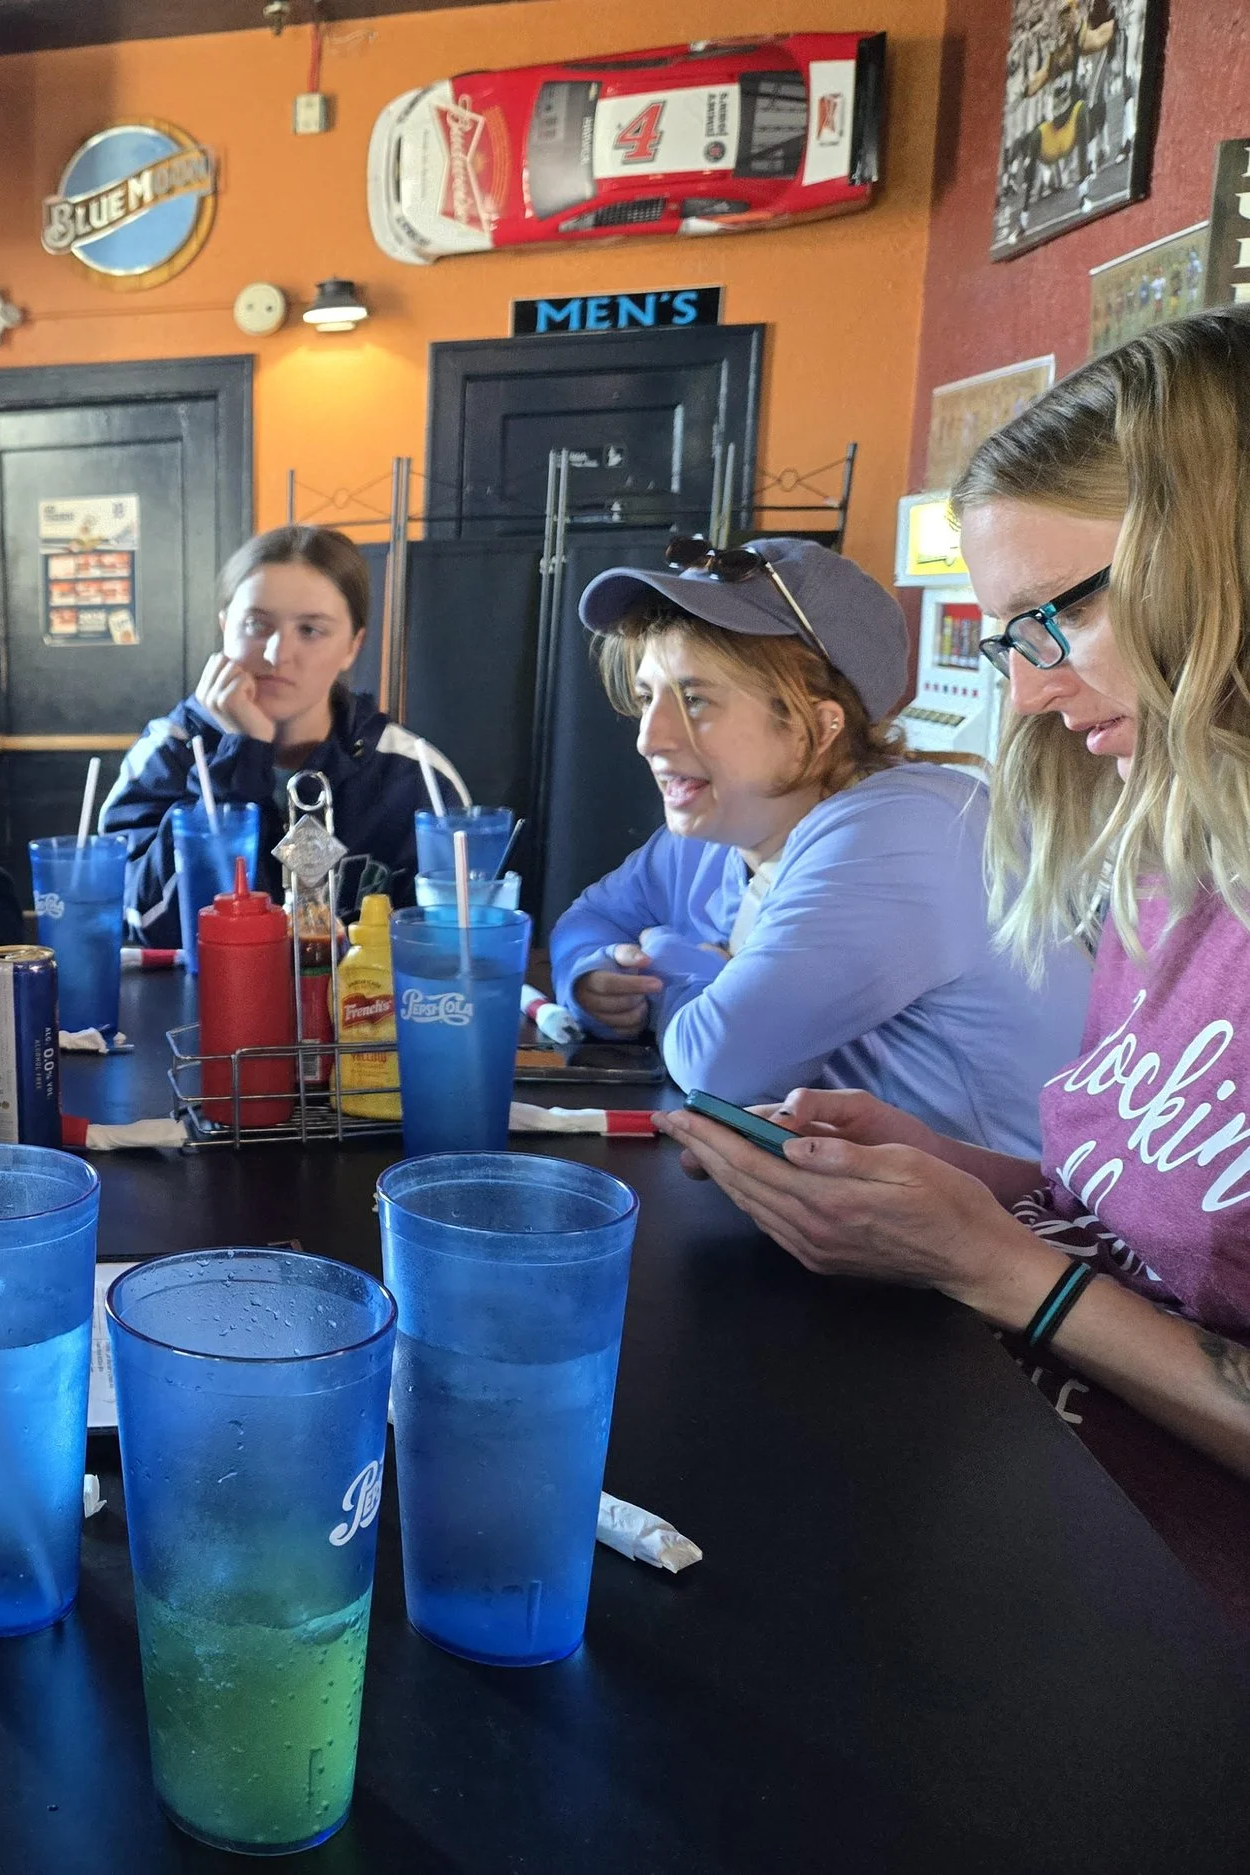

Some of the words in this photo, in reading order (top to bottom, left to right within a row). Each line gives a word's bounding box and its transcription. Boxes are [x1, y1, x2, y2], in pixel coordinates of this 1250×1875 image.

[613, 99, 667, 165] 4
[43, 187, 127, 249] BLUE
[127, 155, 210, 212] MOON
[535, 290, 699, 334] MEN'S
[343, 1000, 391, 1021] French's
